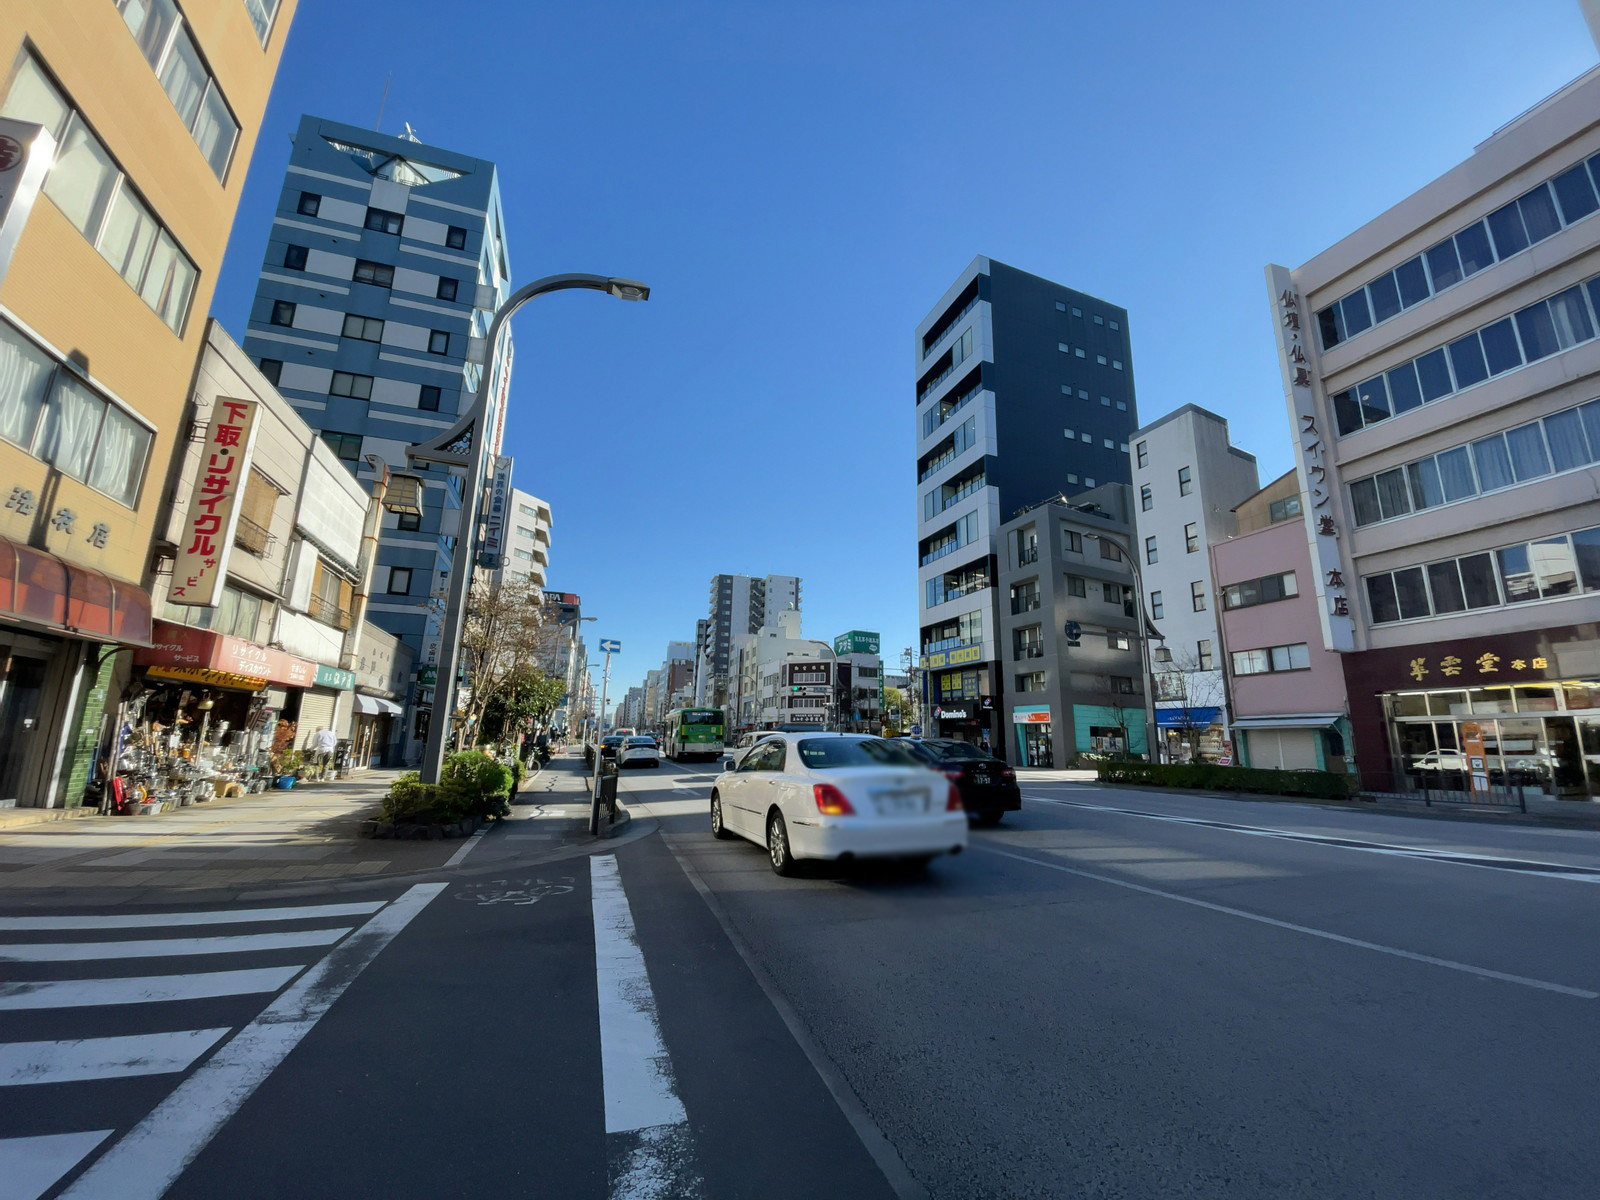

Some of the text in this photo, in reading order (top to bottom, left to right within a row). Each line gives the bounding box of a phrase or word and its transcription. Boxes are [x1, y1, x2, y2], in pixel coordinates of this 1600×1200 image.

[1301, 415, 1337, 536] スイウン堂
[1326, 567, 1349, 616] 本店
[154, 643, 184, 652] サイクル
[232, 644, 268, 662] リサイクル
[1510, 657, 1549, 671] 本店
[941, 709, 967, 719] Domino's
